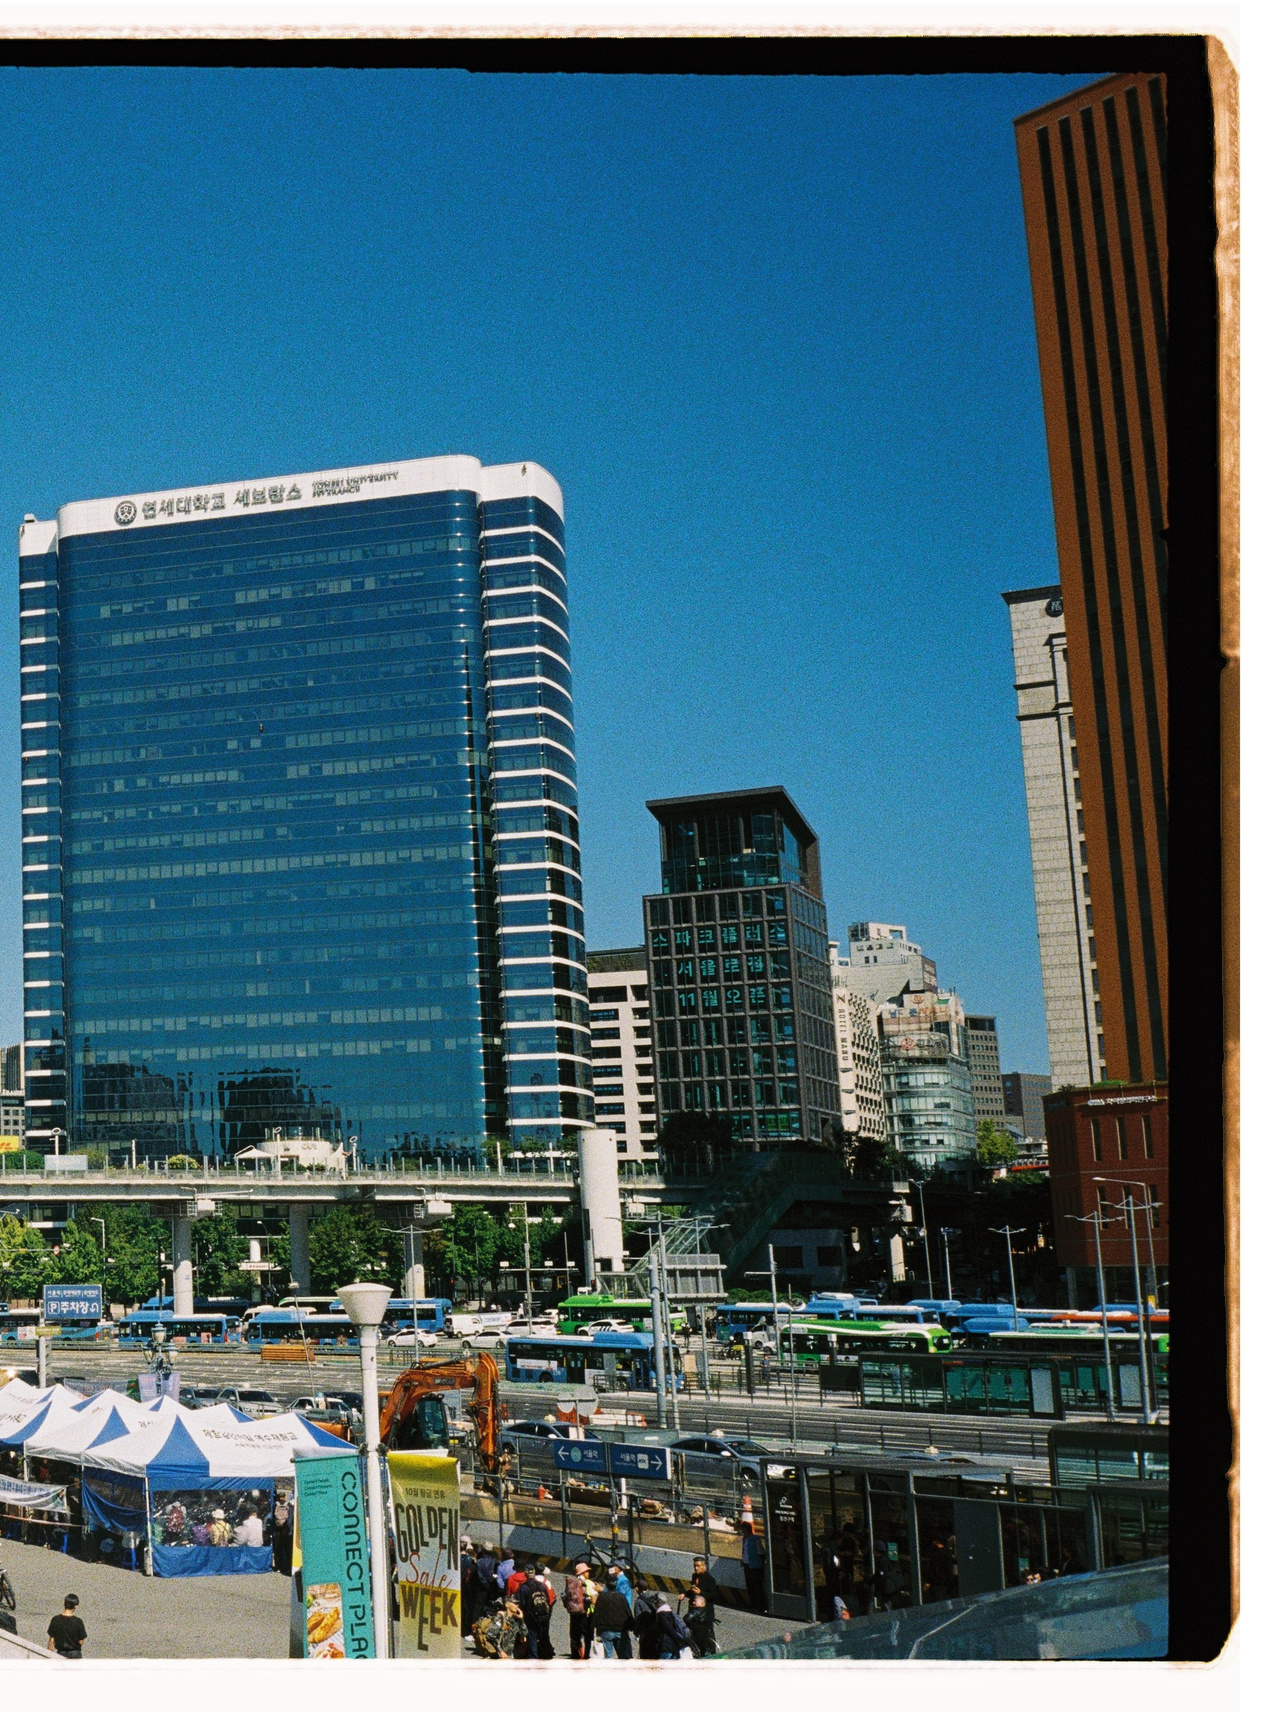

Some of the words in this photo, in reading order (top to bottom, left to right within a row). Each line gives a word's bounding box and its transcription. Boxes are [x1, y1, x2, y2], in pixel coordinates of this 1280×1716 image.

[346, 471, 399, 486] UNIVERSITY
[141, 491, 226, 520] 연세대학교
[233, 483, 302, 509] 세브란스
[652, 922, 785, 947] 스파크플러스
[678, 955, 764, 978] 서울로점
[838, 1008, 847, 1033] HOTEL
[61, 1301, 89, 1314] 주차장
[405, 1487, 419, 1498] 10월
[434, 1489, 446, 1500] 연휴
[341, 1471, 365, 1595] CONNECT
[394, 1502, 459, 1571] GOLDEN
[406, 1546, 452, 1602] Sale
[400, 1584, 459, 1651] WEEK
